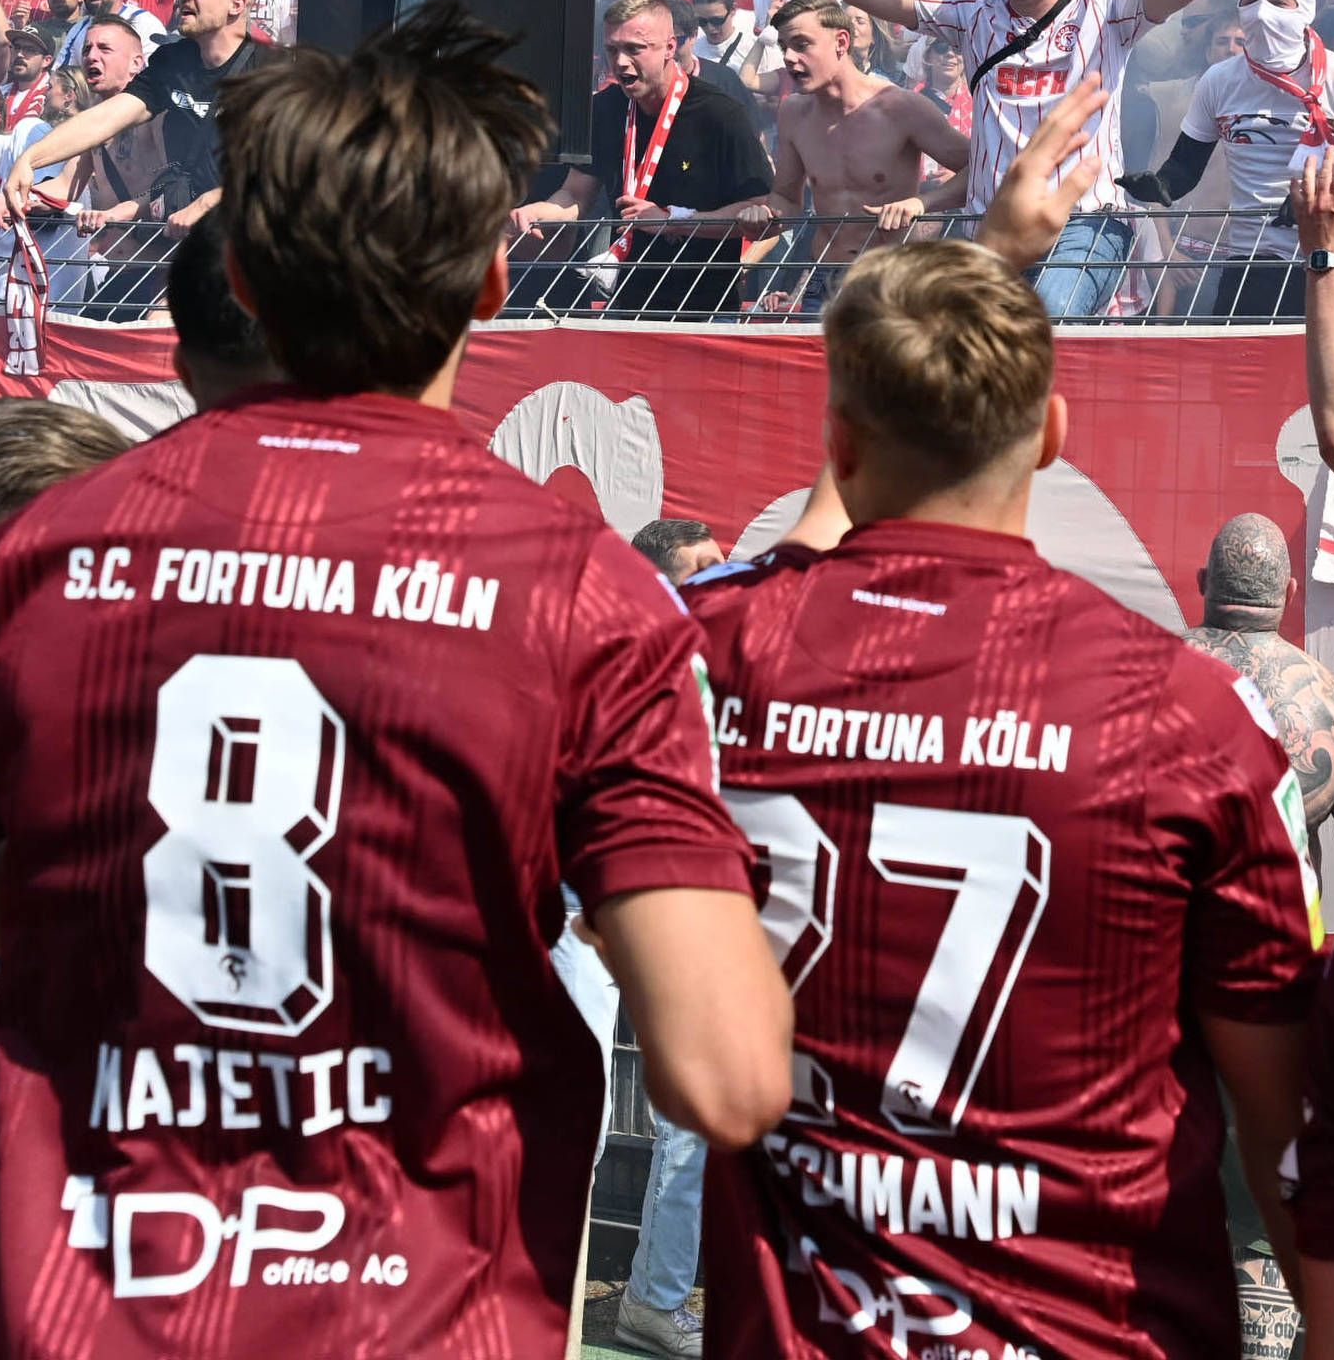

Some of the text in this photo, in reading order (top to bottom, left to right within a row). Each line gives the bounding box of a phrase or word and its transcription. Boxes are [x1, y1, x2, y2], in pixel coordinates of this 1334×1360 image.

[64, 547, 500, 632] S.C. FORTUNA KÖLN
[717, 700, 1073, 773] C. FORTUNA KÖLN
[143, 653, 345, 1037] 8
[262, 1255, 409, 1287] office AG
